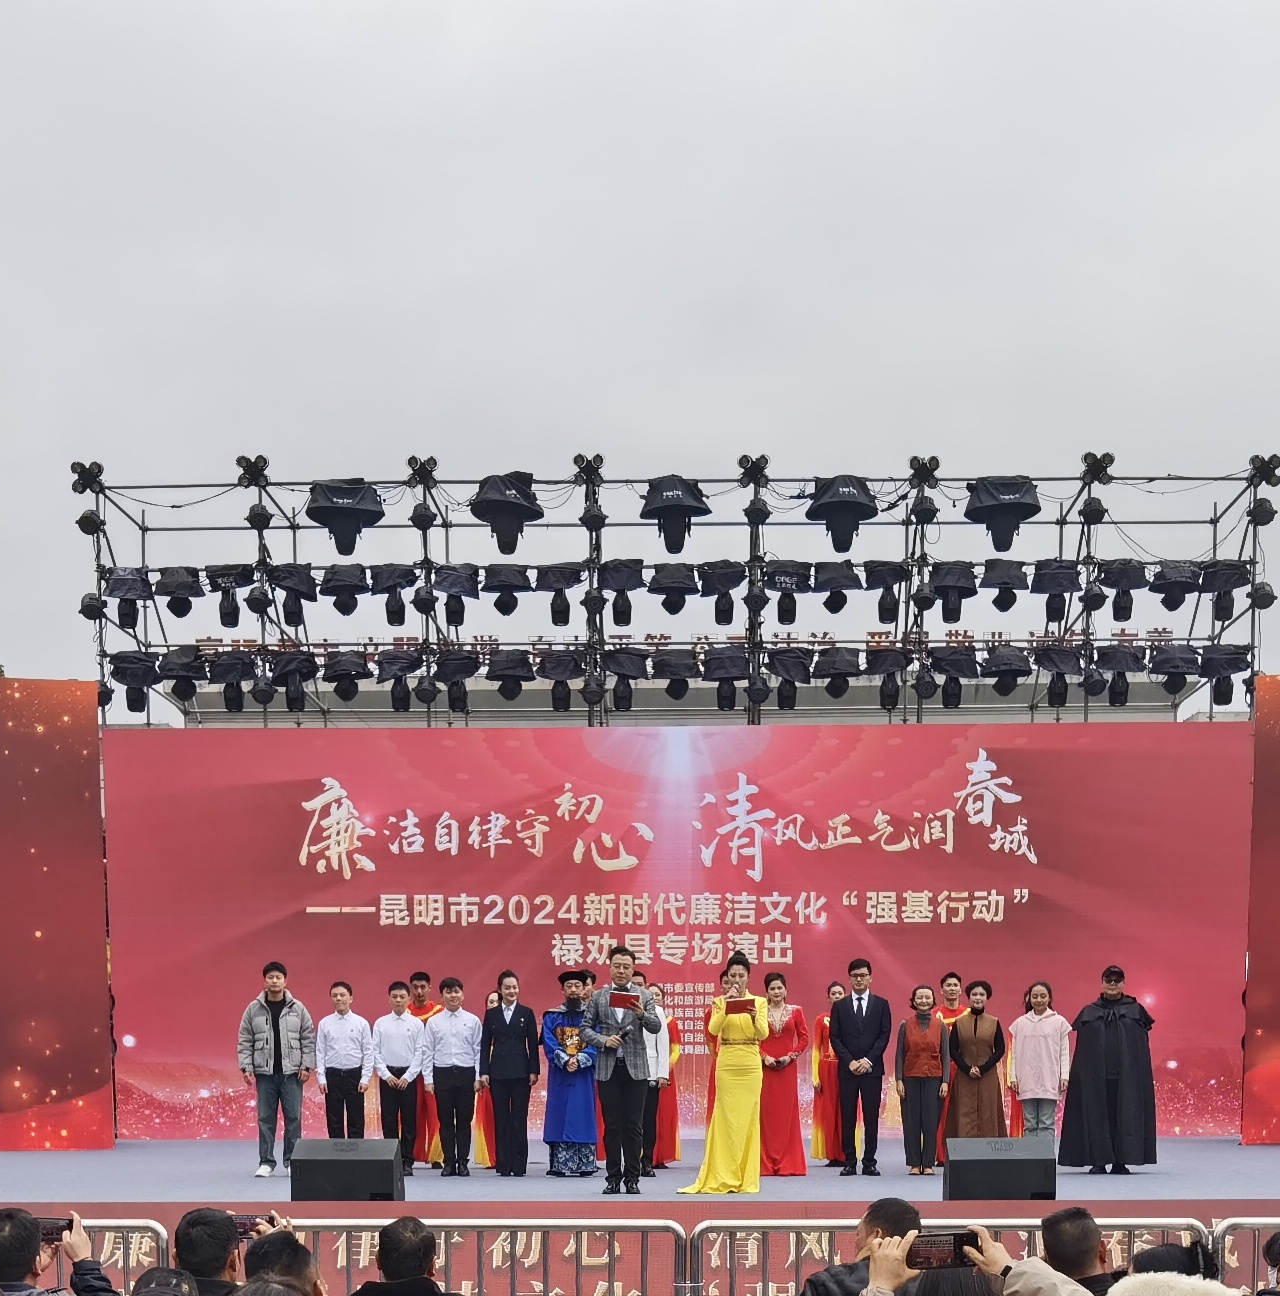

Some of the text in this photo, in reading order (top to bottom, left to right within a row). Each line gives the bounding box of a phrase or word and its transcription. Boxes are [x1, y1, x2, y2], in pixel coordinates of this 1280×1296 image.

[299, 748, 1038, 882] 廉洁自律守初心 清风正气润春城
[551, 931, 794, 966] 禄劝县专场演出
[659, 982, 715, 993] 市委宣传部
